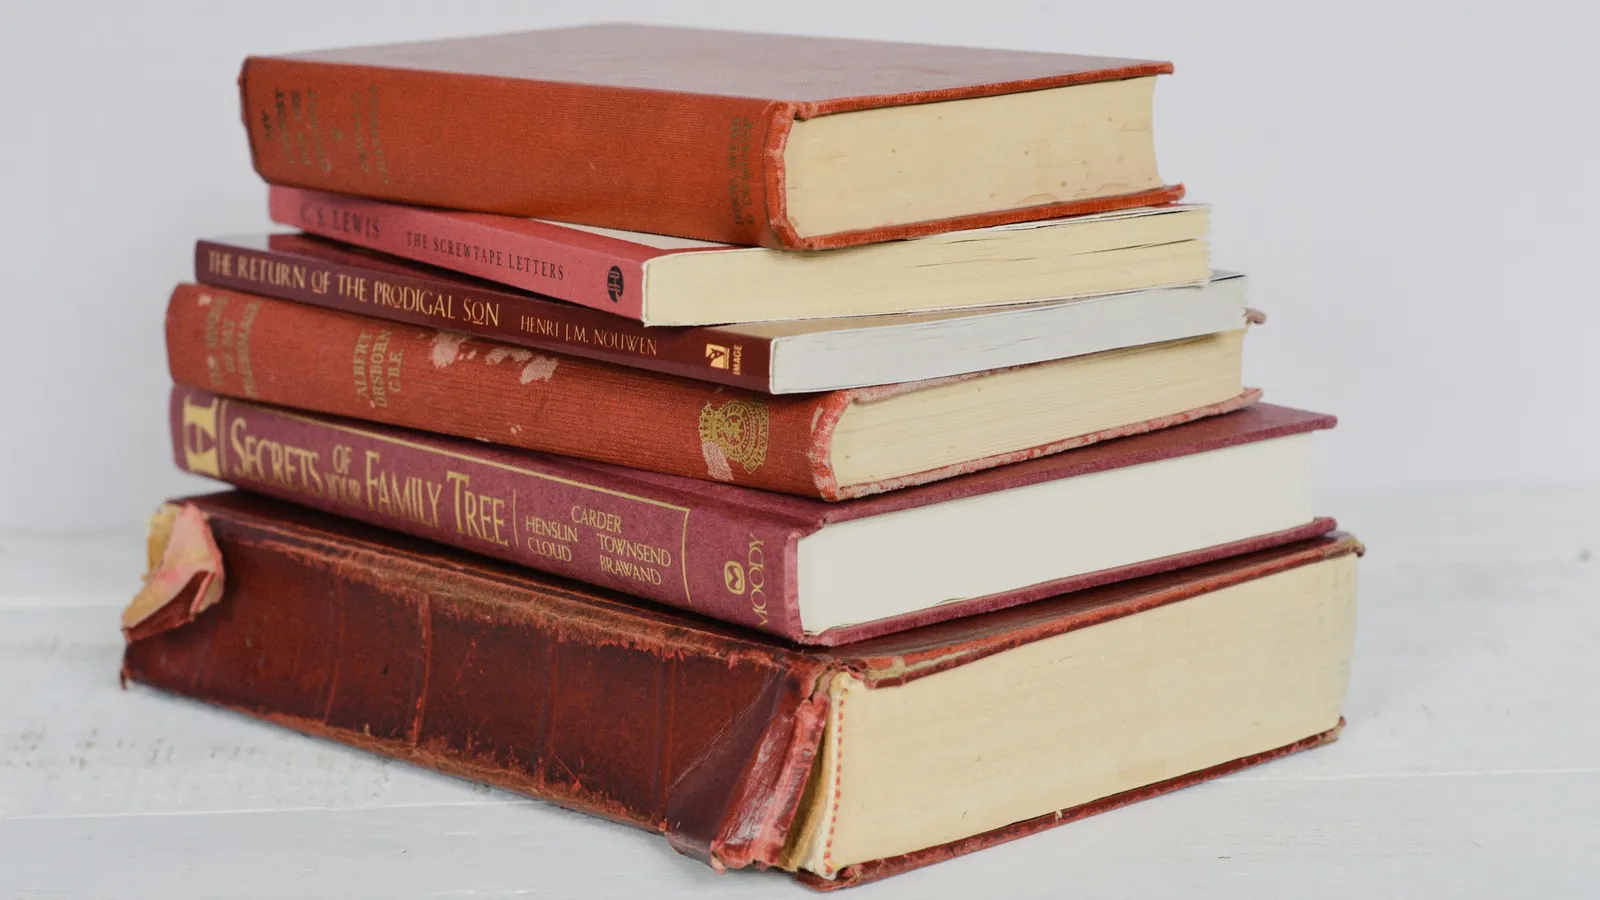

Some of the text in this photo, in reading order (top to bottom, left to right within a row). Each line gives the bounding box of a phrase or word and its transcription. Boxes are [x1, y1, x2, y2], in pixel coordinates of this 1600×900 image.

[332, 209, 380, 239] LEWIS
[407, 230, 565, 281] THE SCREWTAPE LETTERS
[208, 250, 501, 328] THE RETURN OF THE PRODIGAL SON
[520, 314, 657, 356] HENRI J.M. NOUWEN
[353, 330, 373, 402] ALBERT
[732, 344, 743, 376] IMAGE
[332, 444, 352, 475] OF
[525, 515, 578, 543] HENSLIN
[571, 505, 622, 534] CARDER
[527, 537, 572, 563] CLOUD
[596, 532, 672, 568] TOWNSEND
[599, 554, 662, 587] BRAWAND
[748, 533, 769, 626] MOODY
